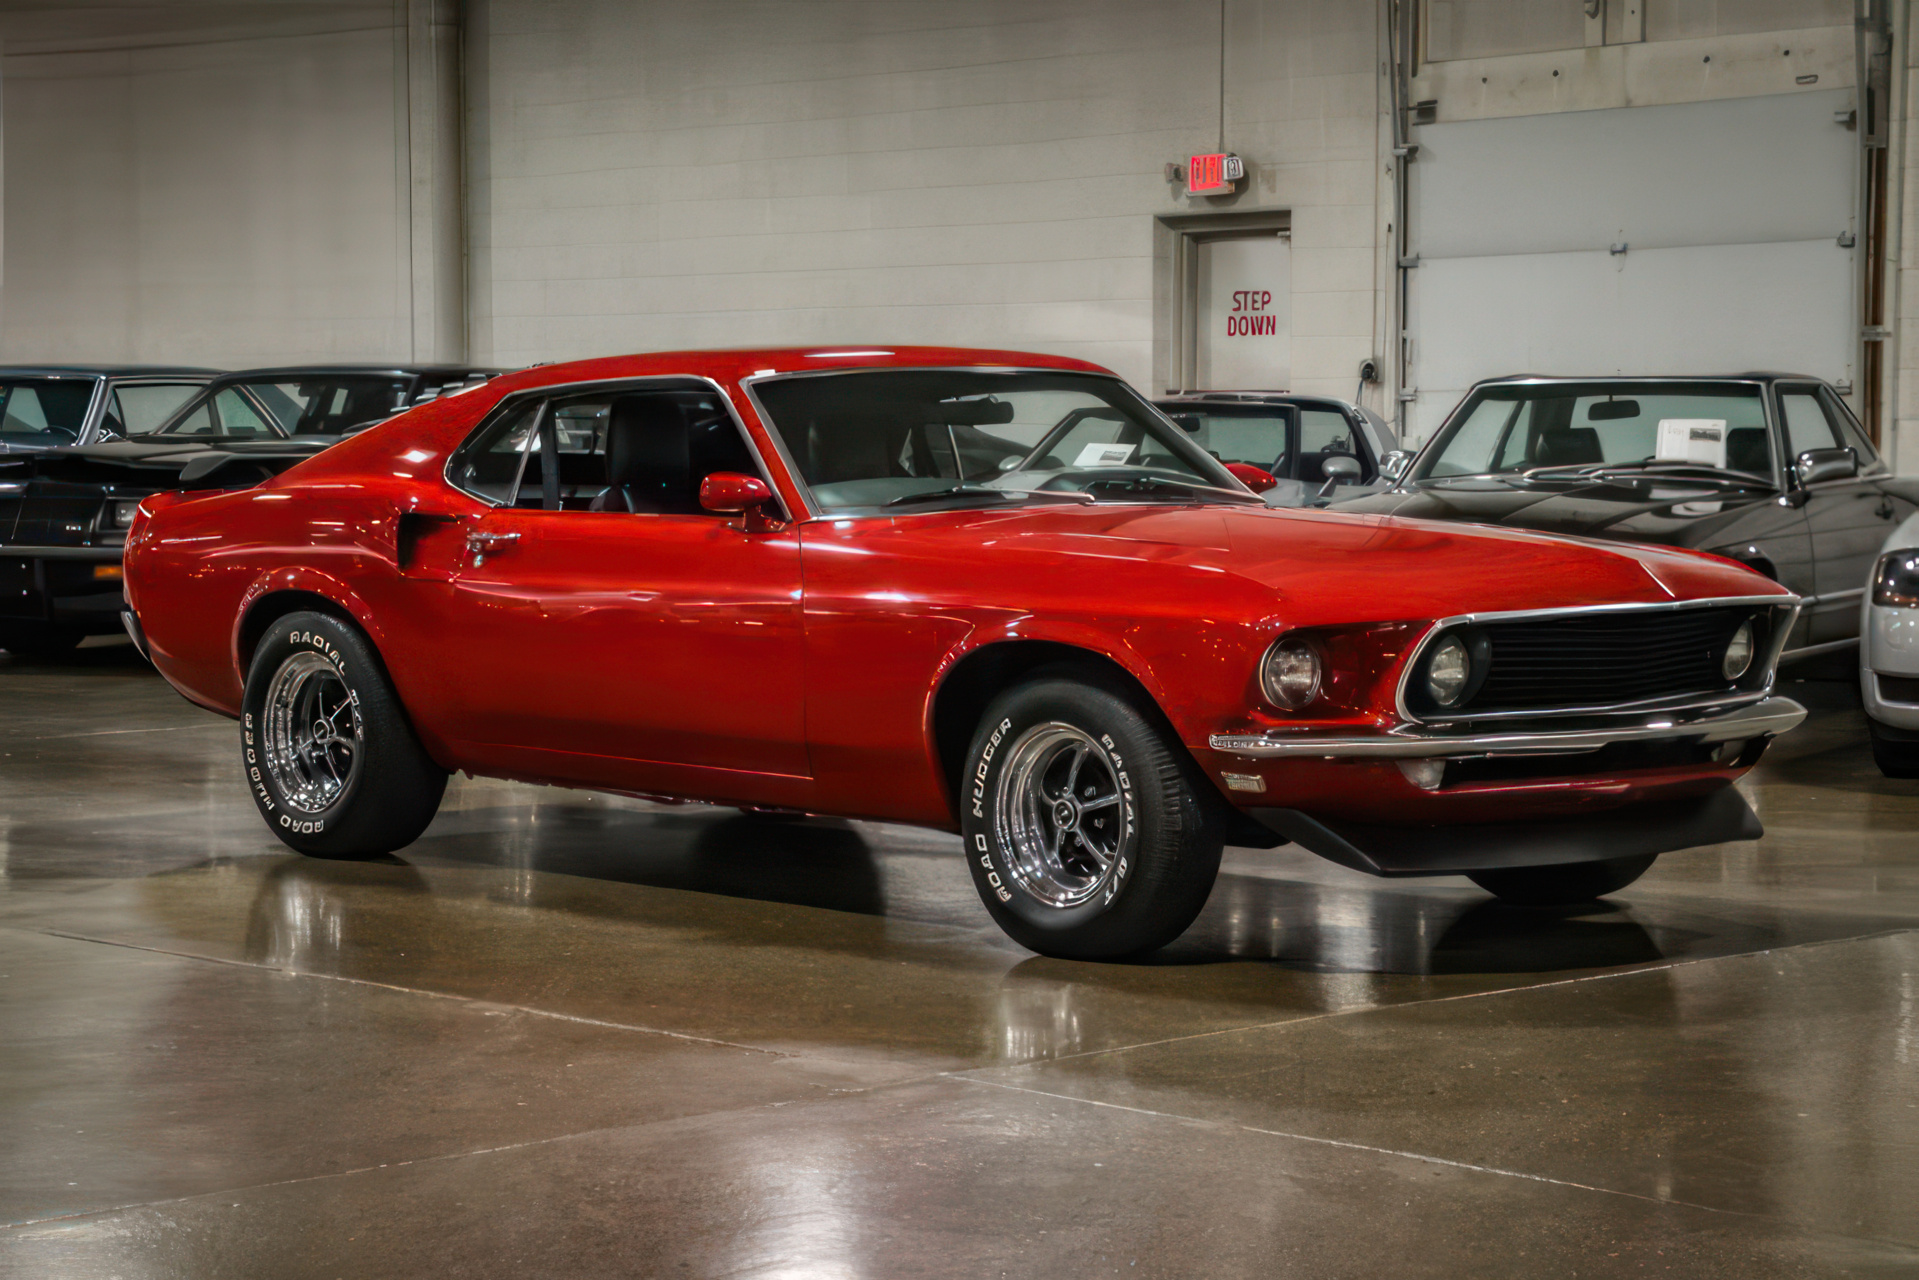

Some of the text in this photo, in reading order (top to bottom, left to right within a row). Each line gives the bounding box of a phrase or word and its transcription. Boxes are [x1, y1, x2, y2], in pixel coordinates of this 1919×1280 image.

[1232, 291, 1272, 311] STEP
[1227, 315, 1276, 336] DOWN
[289, 631, 346, 676] RADIAL
[972, 718, 1012, 902] ROAD HUGGER
[280, 814, 324, 834] ROAD
